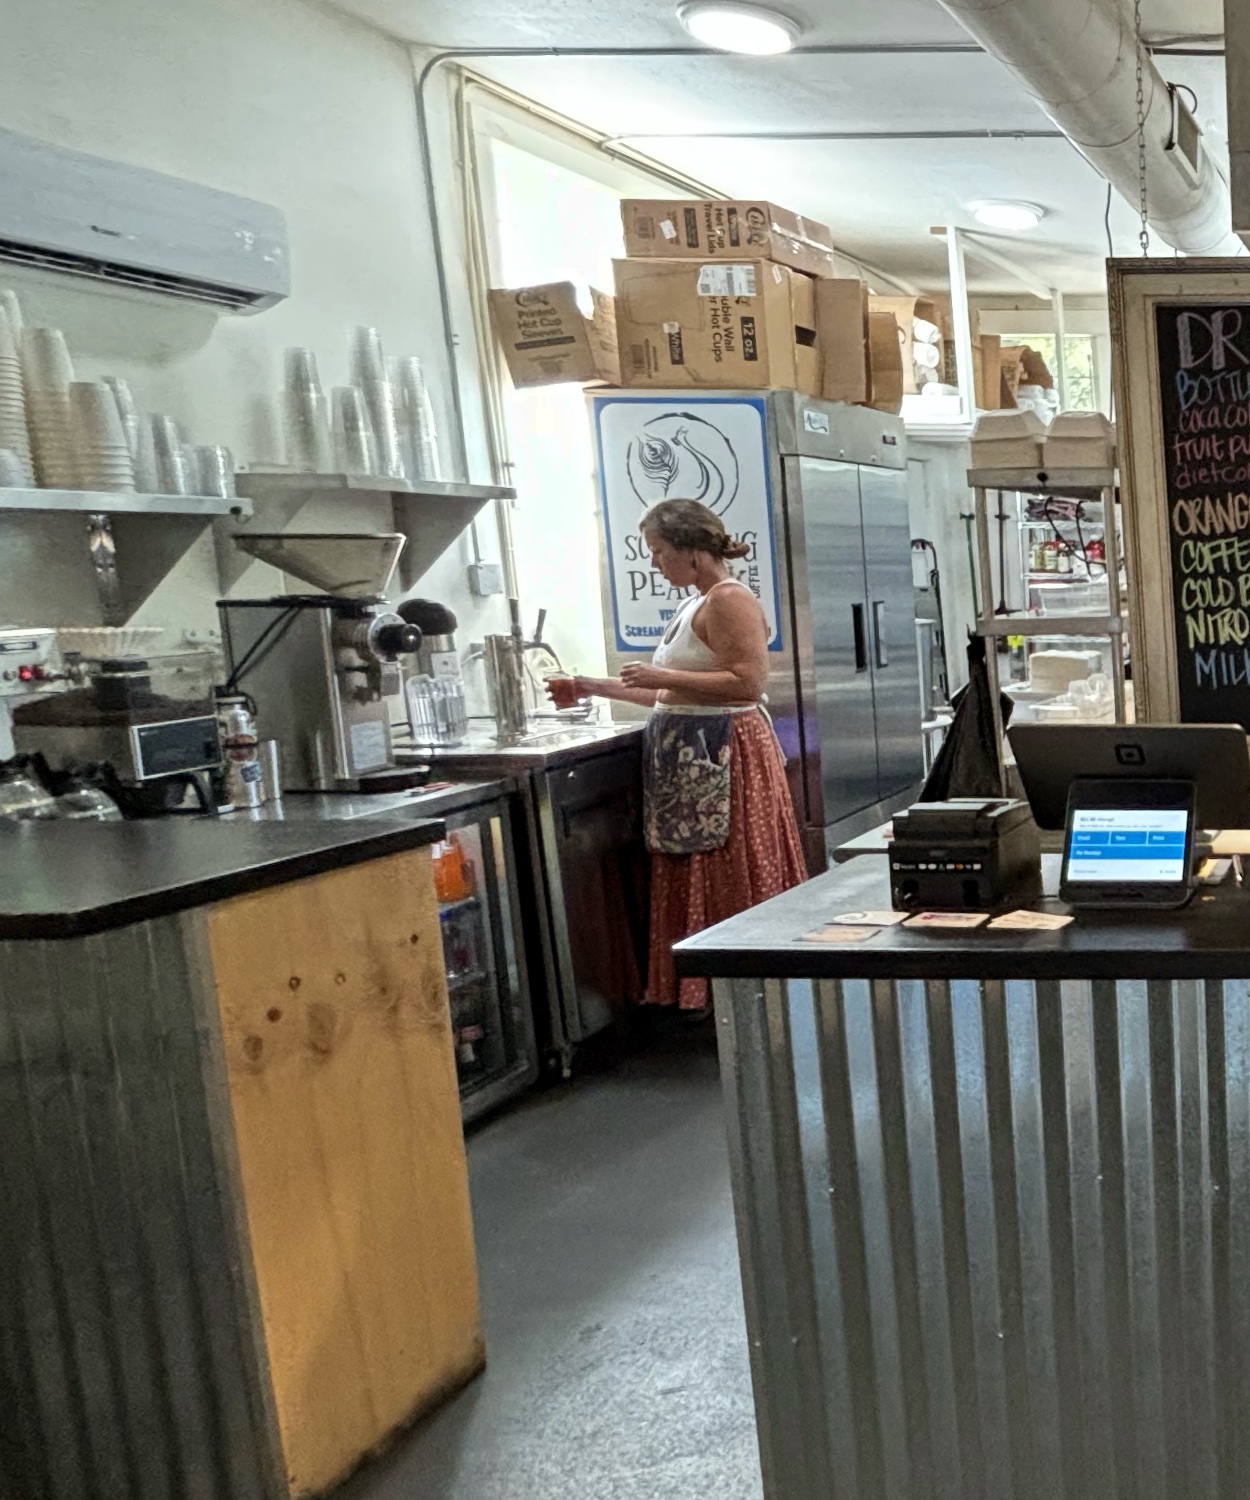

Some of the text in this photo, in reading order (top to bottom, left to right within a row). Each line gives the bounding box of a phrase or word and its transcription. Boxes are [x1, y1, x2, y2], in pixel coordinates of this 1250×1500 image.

[704, 203, 715, 254] Travel Lids
[715, 208, 724, 226] Hot
[517, 307, 557, 320] Printed
[517, 317, 562, 329] Hot Cup
[711, 308, 721, 330] Hot
[723, 328, 735, 352] Wall
[743, 323, 755, 336] 12
[712, 333, 722, 363] Cups
[1173, 432, 1224, 466] fruit
[1182, 577, 1234, 611] COLD
[1185, 607, 1250, 649] NITRO
